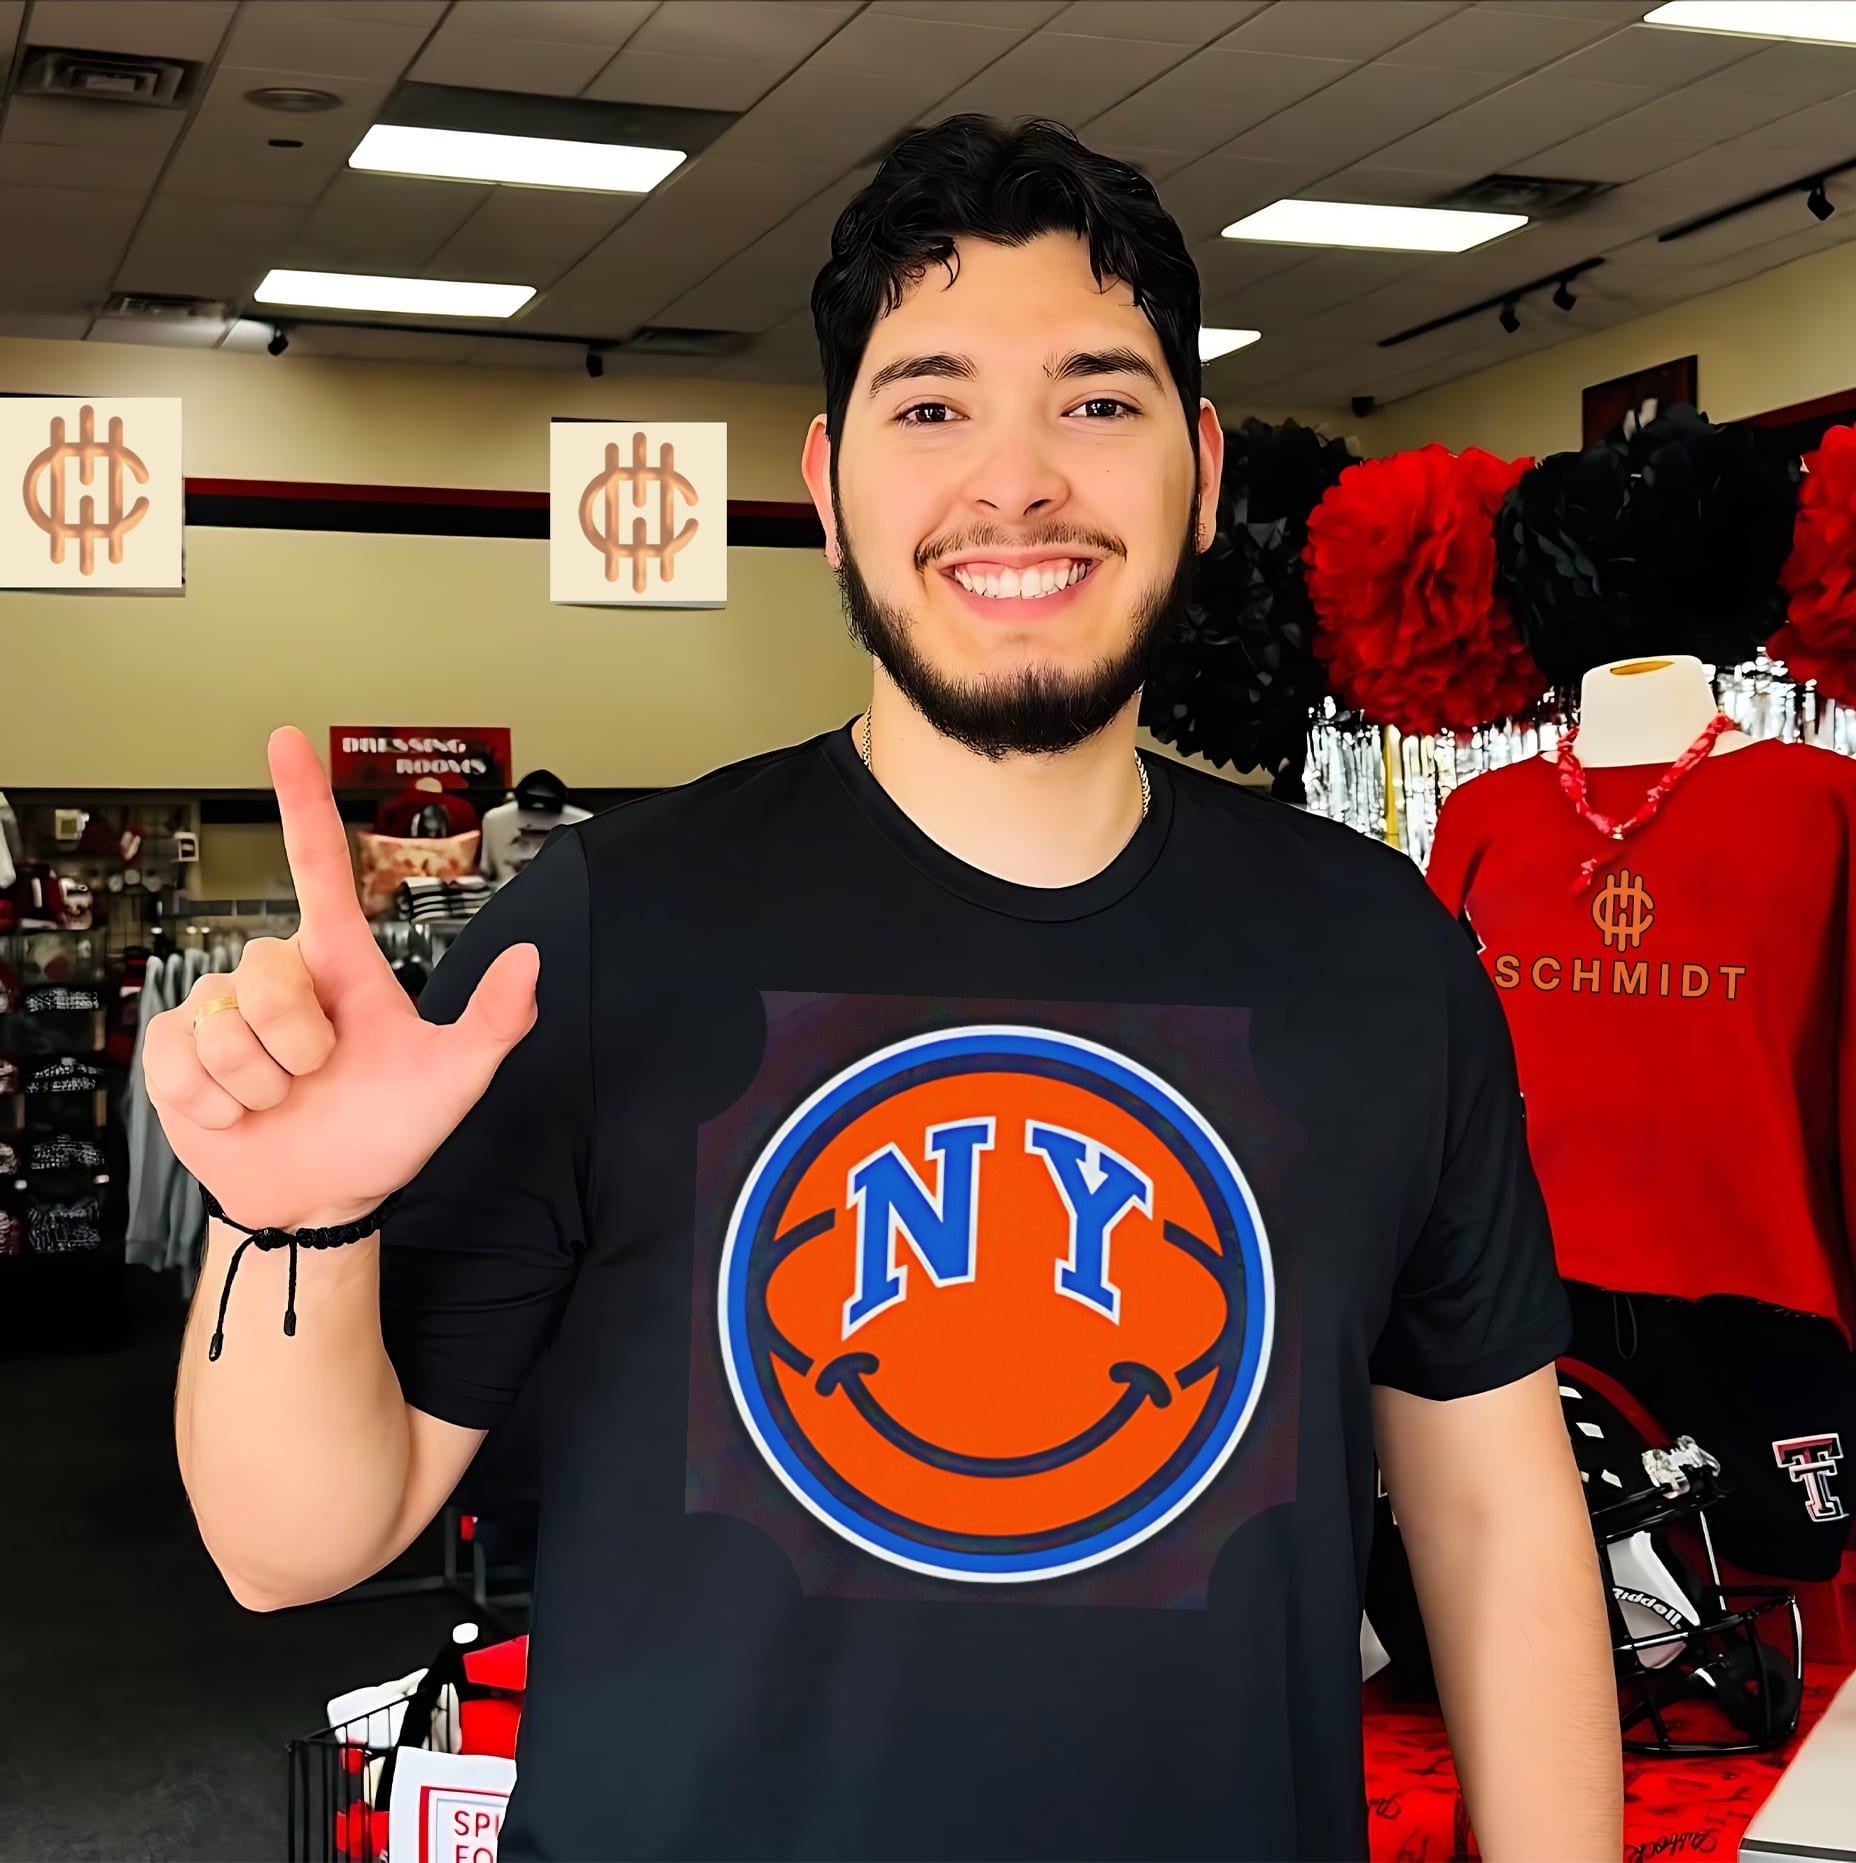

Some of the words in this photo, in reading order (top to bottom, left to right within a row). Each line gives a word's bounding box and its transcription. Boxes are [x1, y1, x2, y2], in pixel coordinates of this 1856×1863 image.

[396, 758, 487, 774] ROOMS
[1493, 953, 1747, 1000] SCHMIDT
[841, 1116, 1153, 1340] NY
